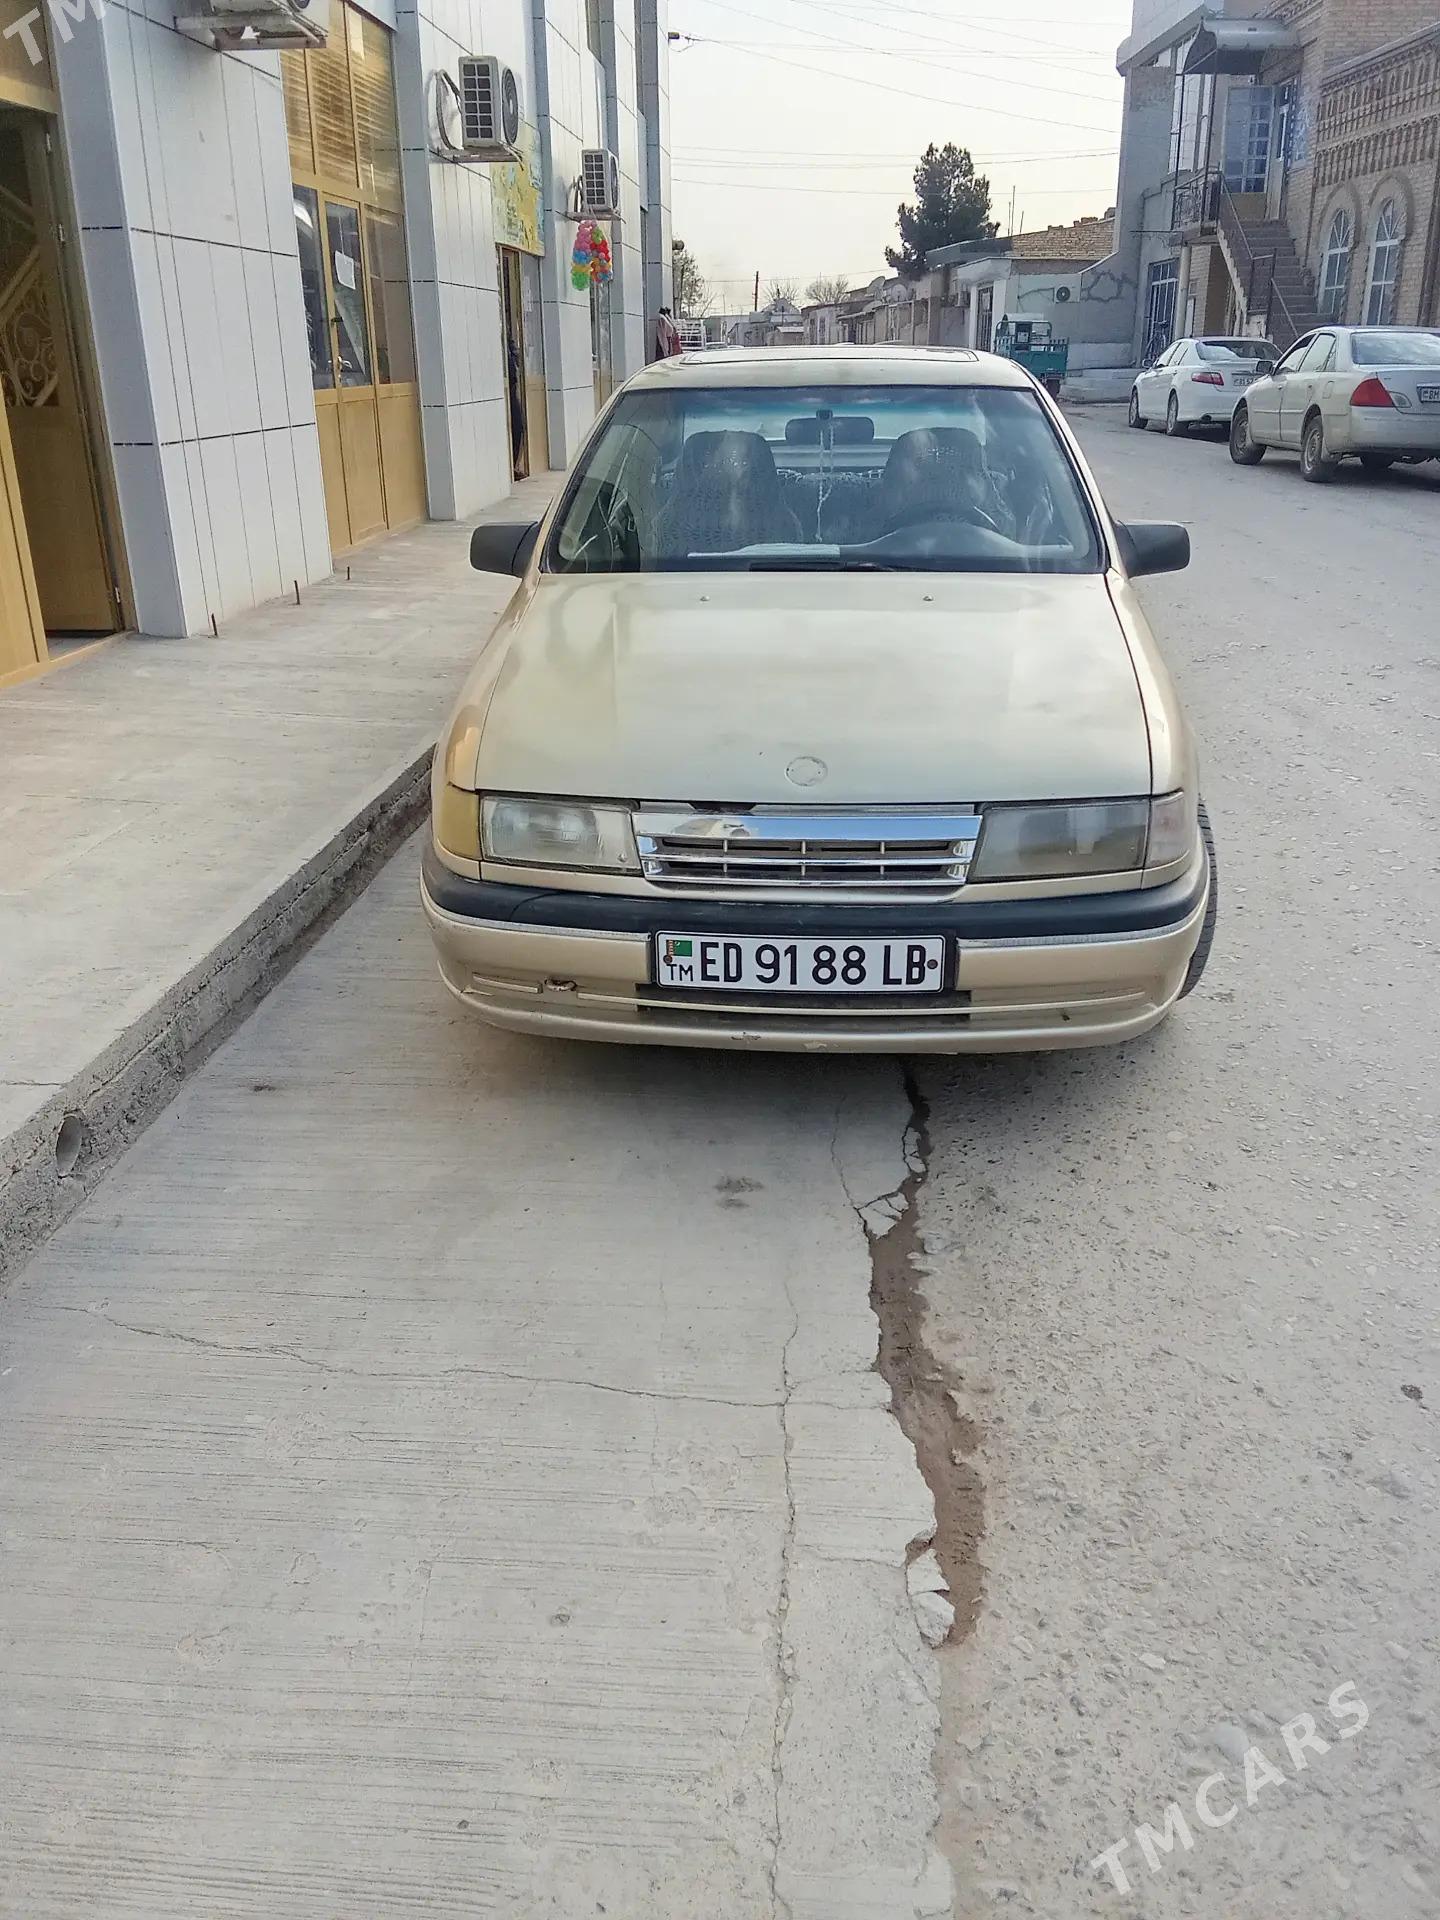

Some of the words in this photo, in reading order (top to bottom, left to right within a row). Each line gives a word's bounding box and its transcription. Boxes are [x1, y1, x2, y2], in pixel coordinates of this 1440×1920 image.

[668, 963, 694, 982] TM
[700, 942, 742, 983] ED
[883, 945, 926, 985] LB
